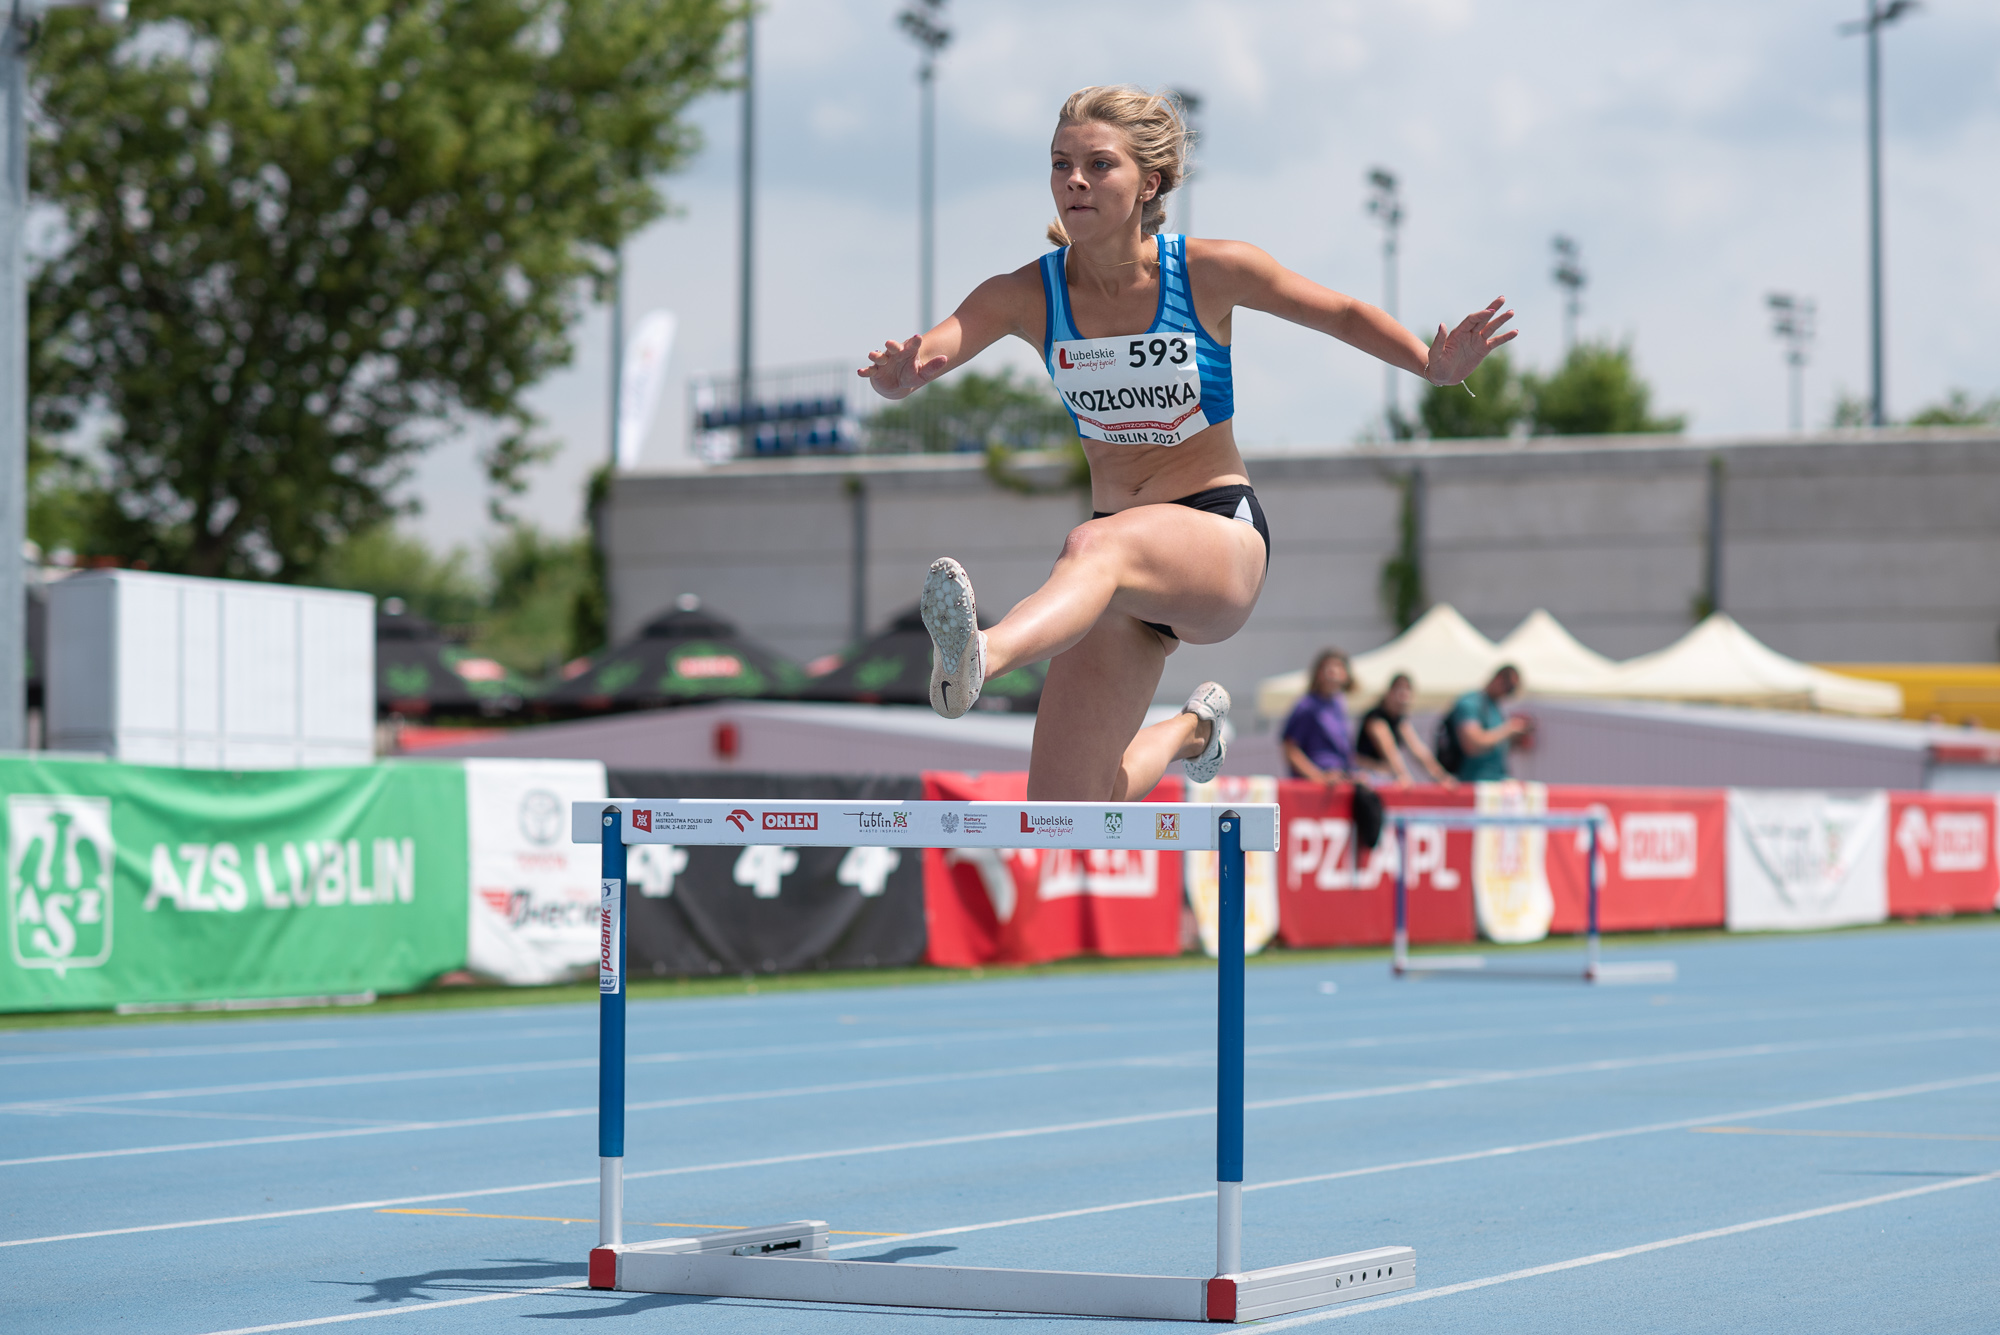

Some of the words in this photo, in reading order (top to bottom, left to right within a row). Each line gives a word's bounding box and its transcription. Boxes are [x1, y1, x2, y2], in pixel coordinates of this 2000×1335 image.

[1129, 338, 1188, 368] 593
[1065, 382, 1196, 412] KOZŁOWSKA
[1104, 432, 1148, 443] LUBLIN
[1152, 431, 1181, 444] 2021
[765, 814, 815, 828] ORLEN
[1157, 830, 1178, 839] PZLA
[144, 842, 248, 912] AZS
[255, 837, 415, 910] LUBLIN
[601, 907, 614, 972] polanik
